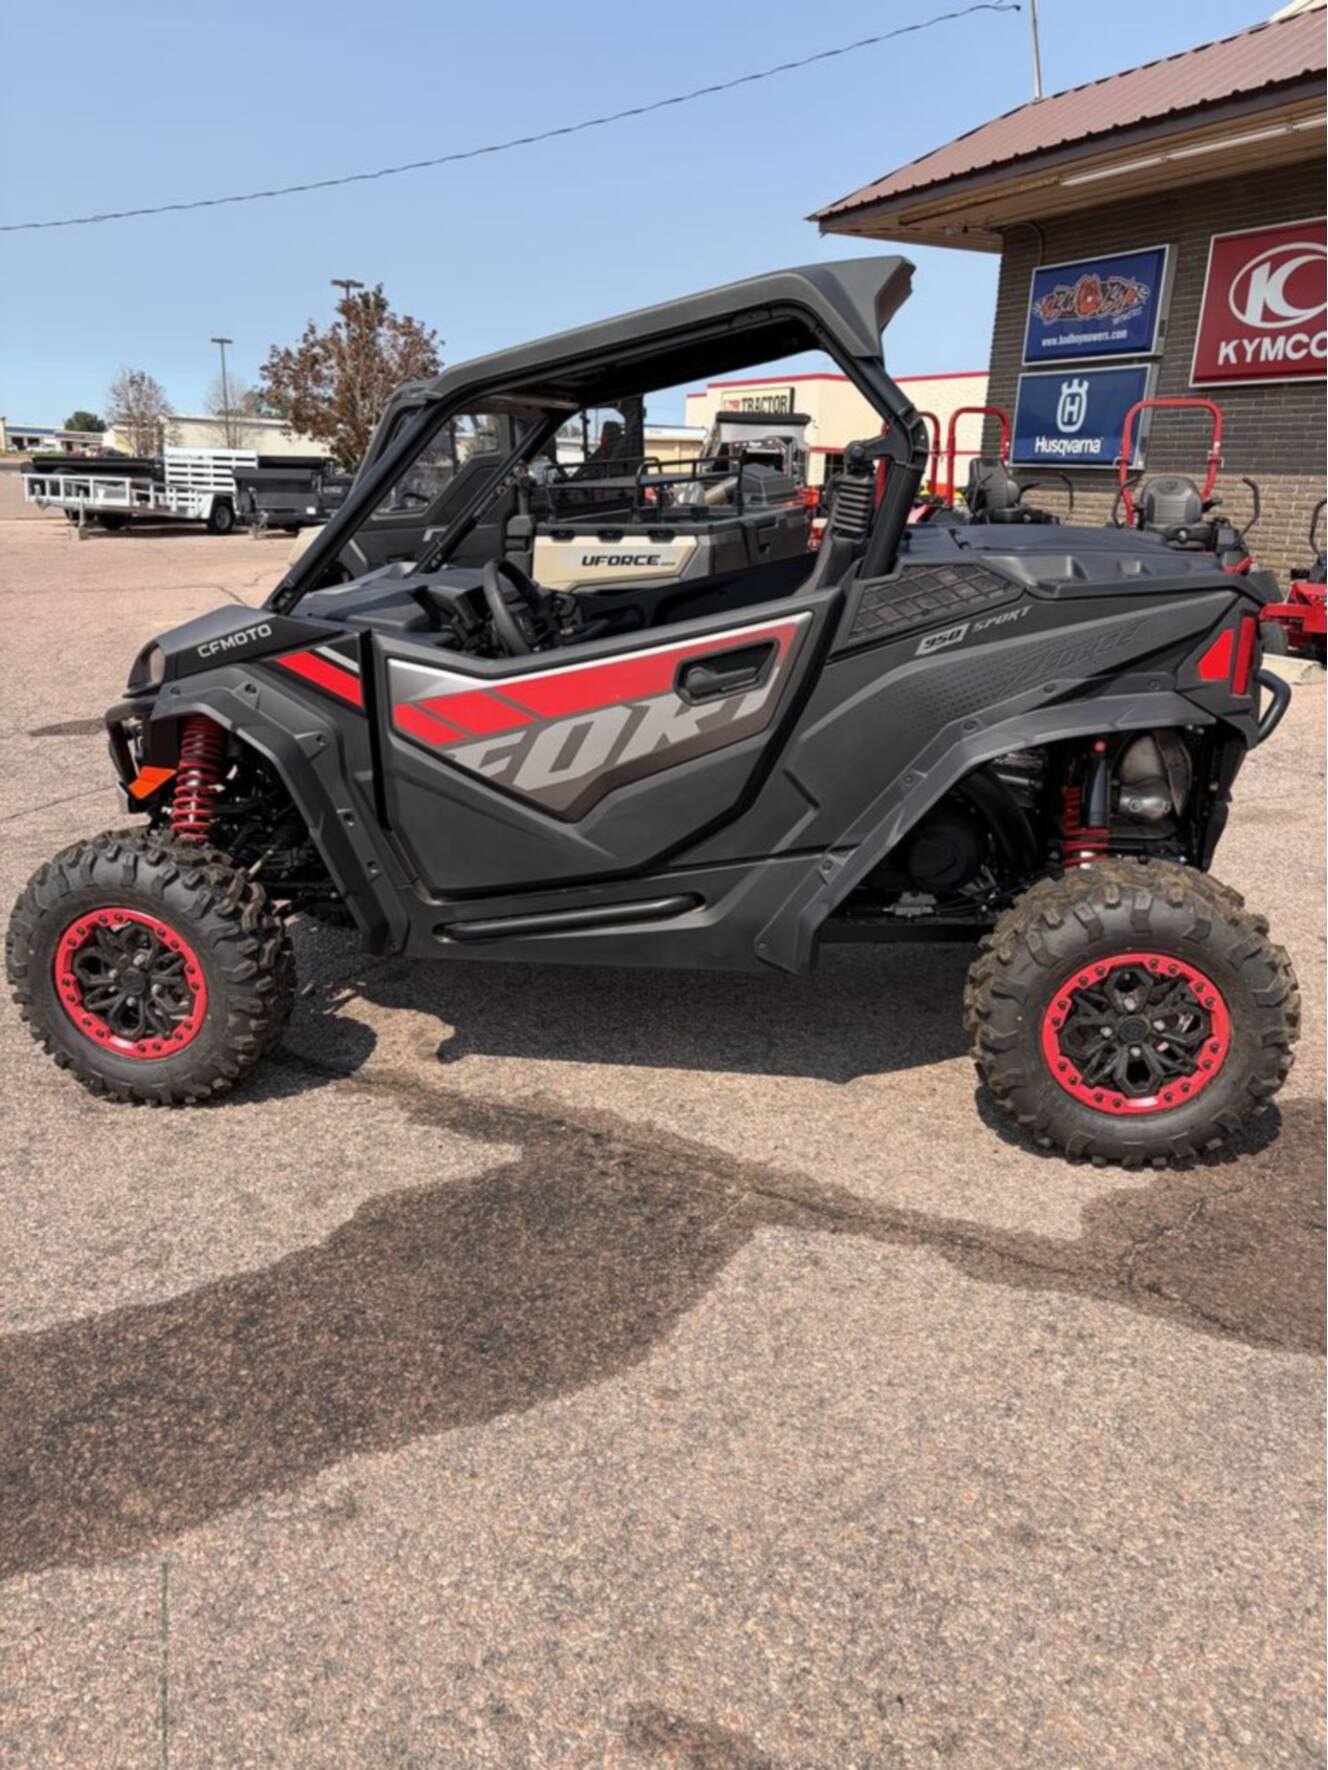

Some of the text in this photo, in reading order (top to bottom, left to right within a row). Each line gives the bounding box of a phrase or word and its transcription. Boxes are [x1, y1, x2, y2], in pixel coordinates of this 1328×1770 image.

[1217, 330, 1328, 366] KYMCO
[741, 394, 788, 415] TRACTOR
[1034, 435, 1102, 456] Husqvarna
[581, 554, 661, 567] UFORCE
[197, 623, 272, 658] CFMOTO
[922, 604, 1033, 651] 950 SPORT
